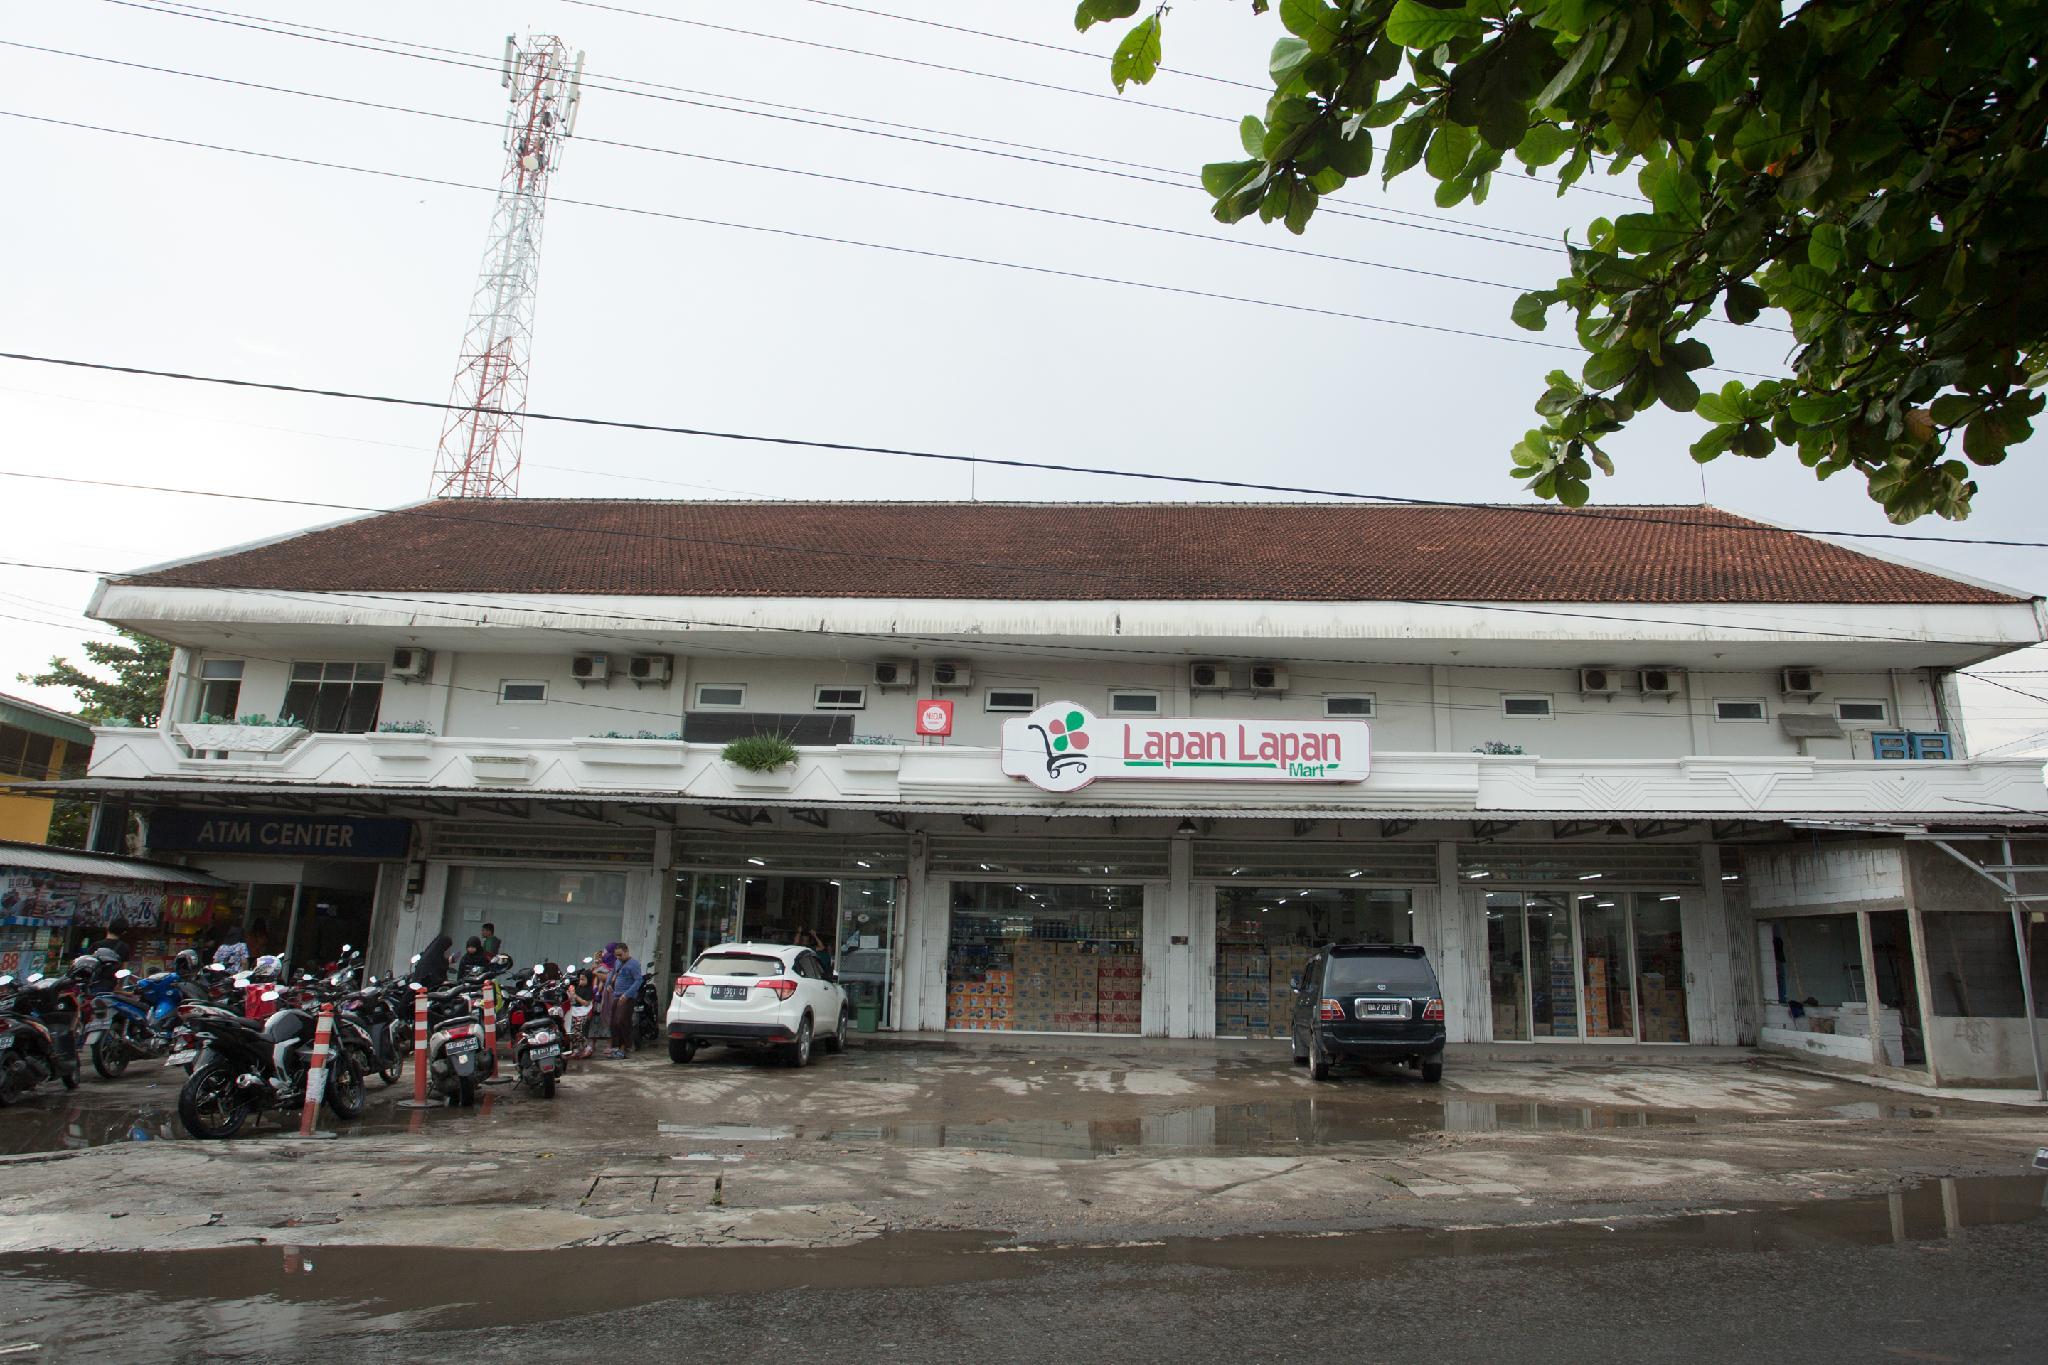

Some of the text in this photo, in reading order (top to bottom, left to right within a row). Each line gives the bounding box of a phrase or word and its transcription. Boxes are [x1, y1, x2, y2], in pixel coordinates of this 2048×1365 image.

[1123, 723, 1342, 771] Lapan Lapan
[1288, 763, 1326, 778] Mart
[197, 821, 354, 848] ATM CENTER
